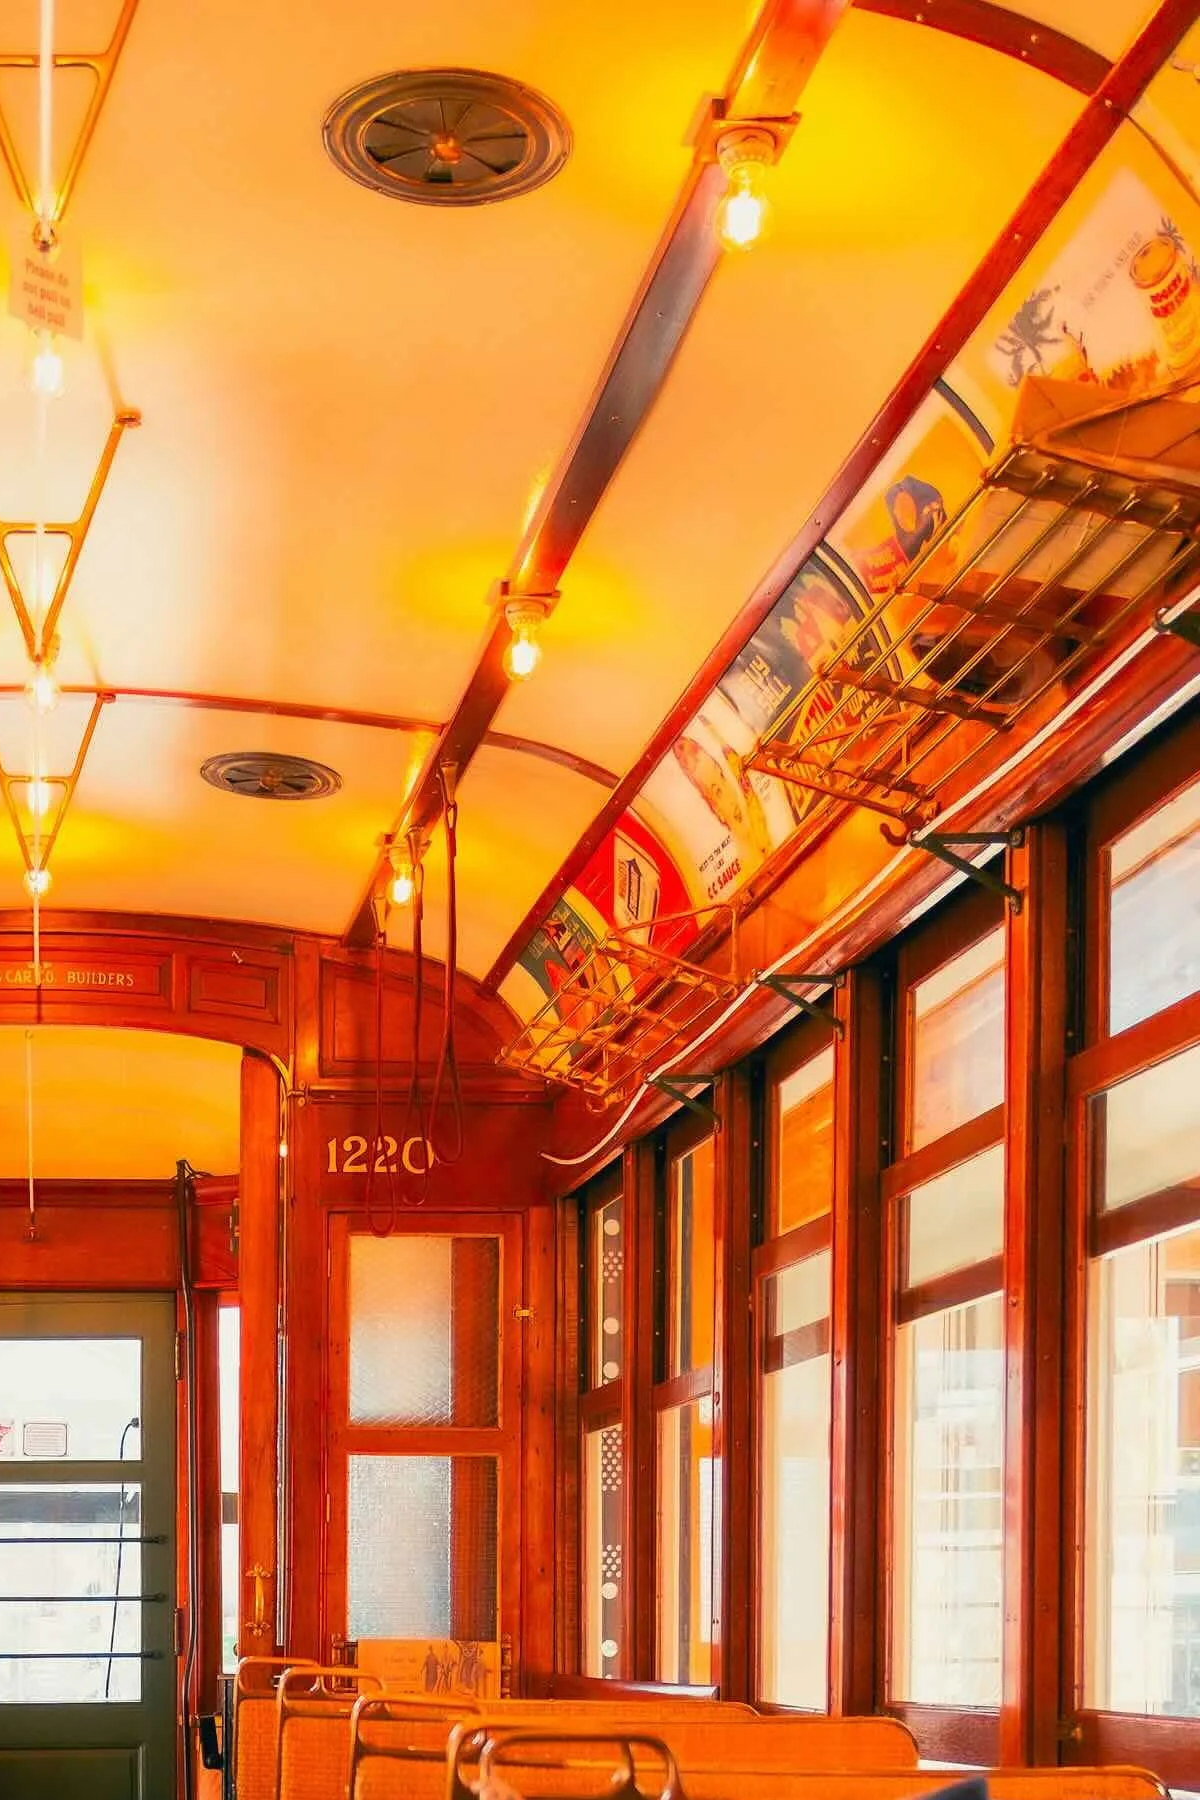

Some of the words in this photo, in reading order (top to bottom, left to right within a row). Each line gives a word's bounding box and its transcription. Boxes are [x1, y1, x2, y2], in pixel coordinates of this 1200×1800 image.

[717, 858, 741, 890] SAUCE
[5, 970, 32, 984] CAR
[66, 970, 134, 987] BUILDERS
[327, 1135, 435, 1175] 1220
